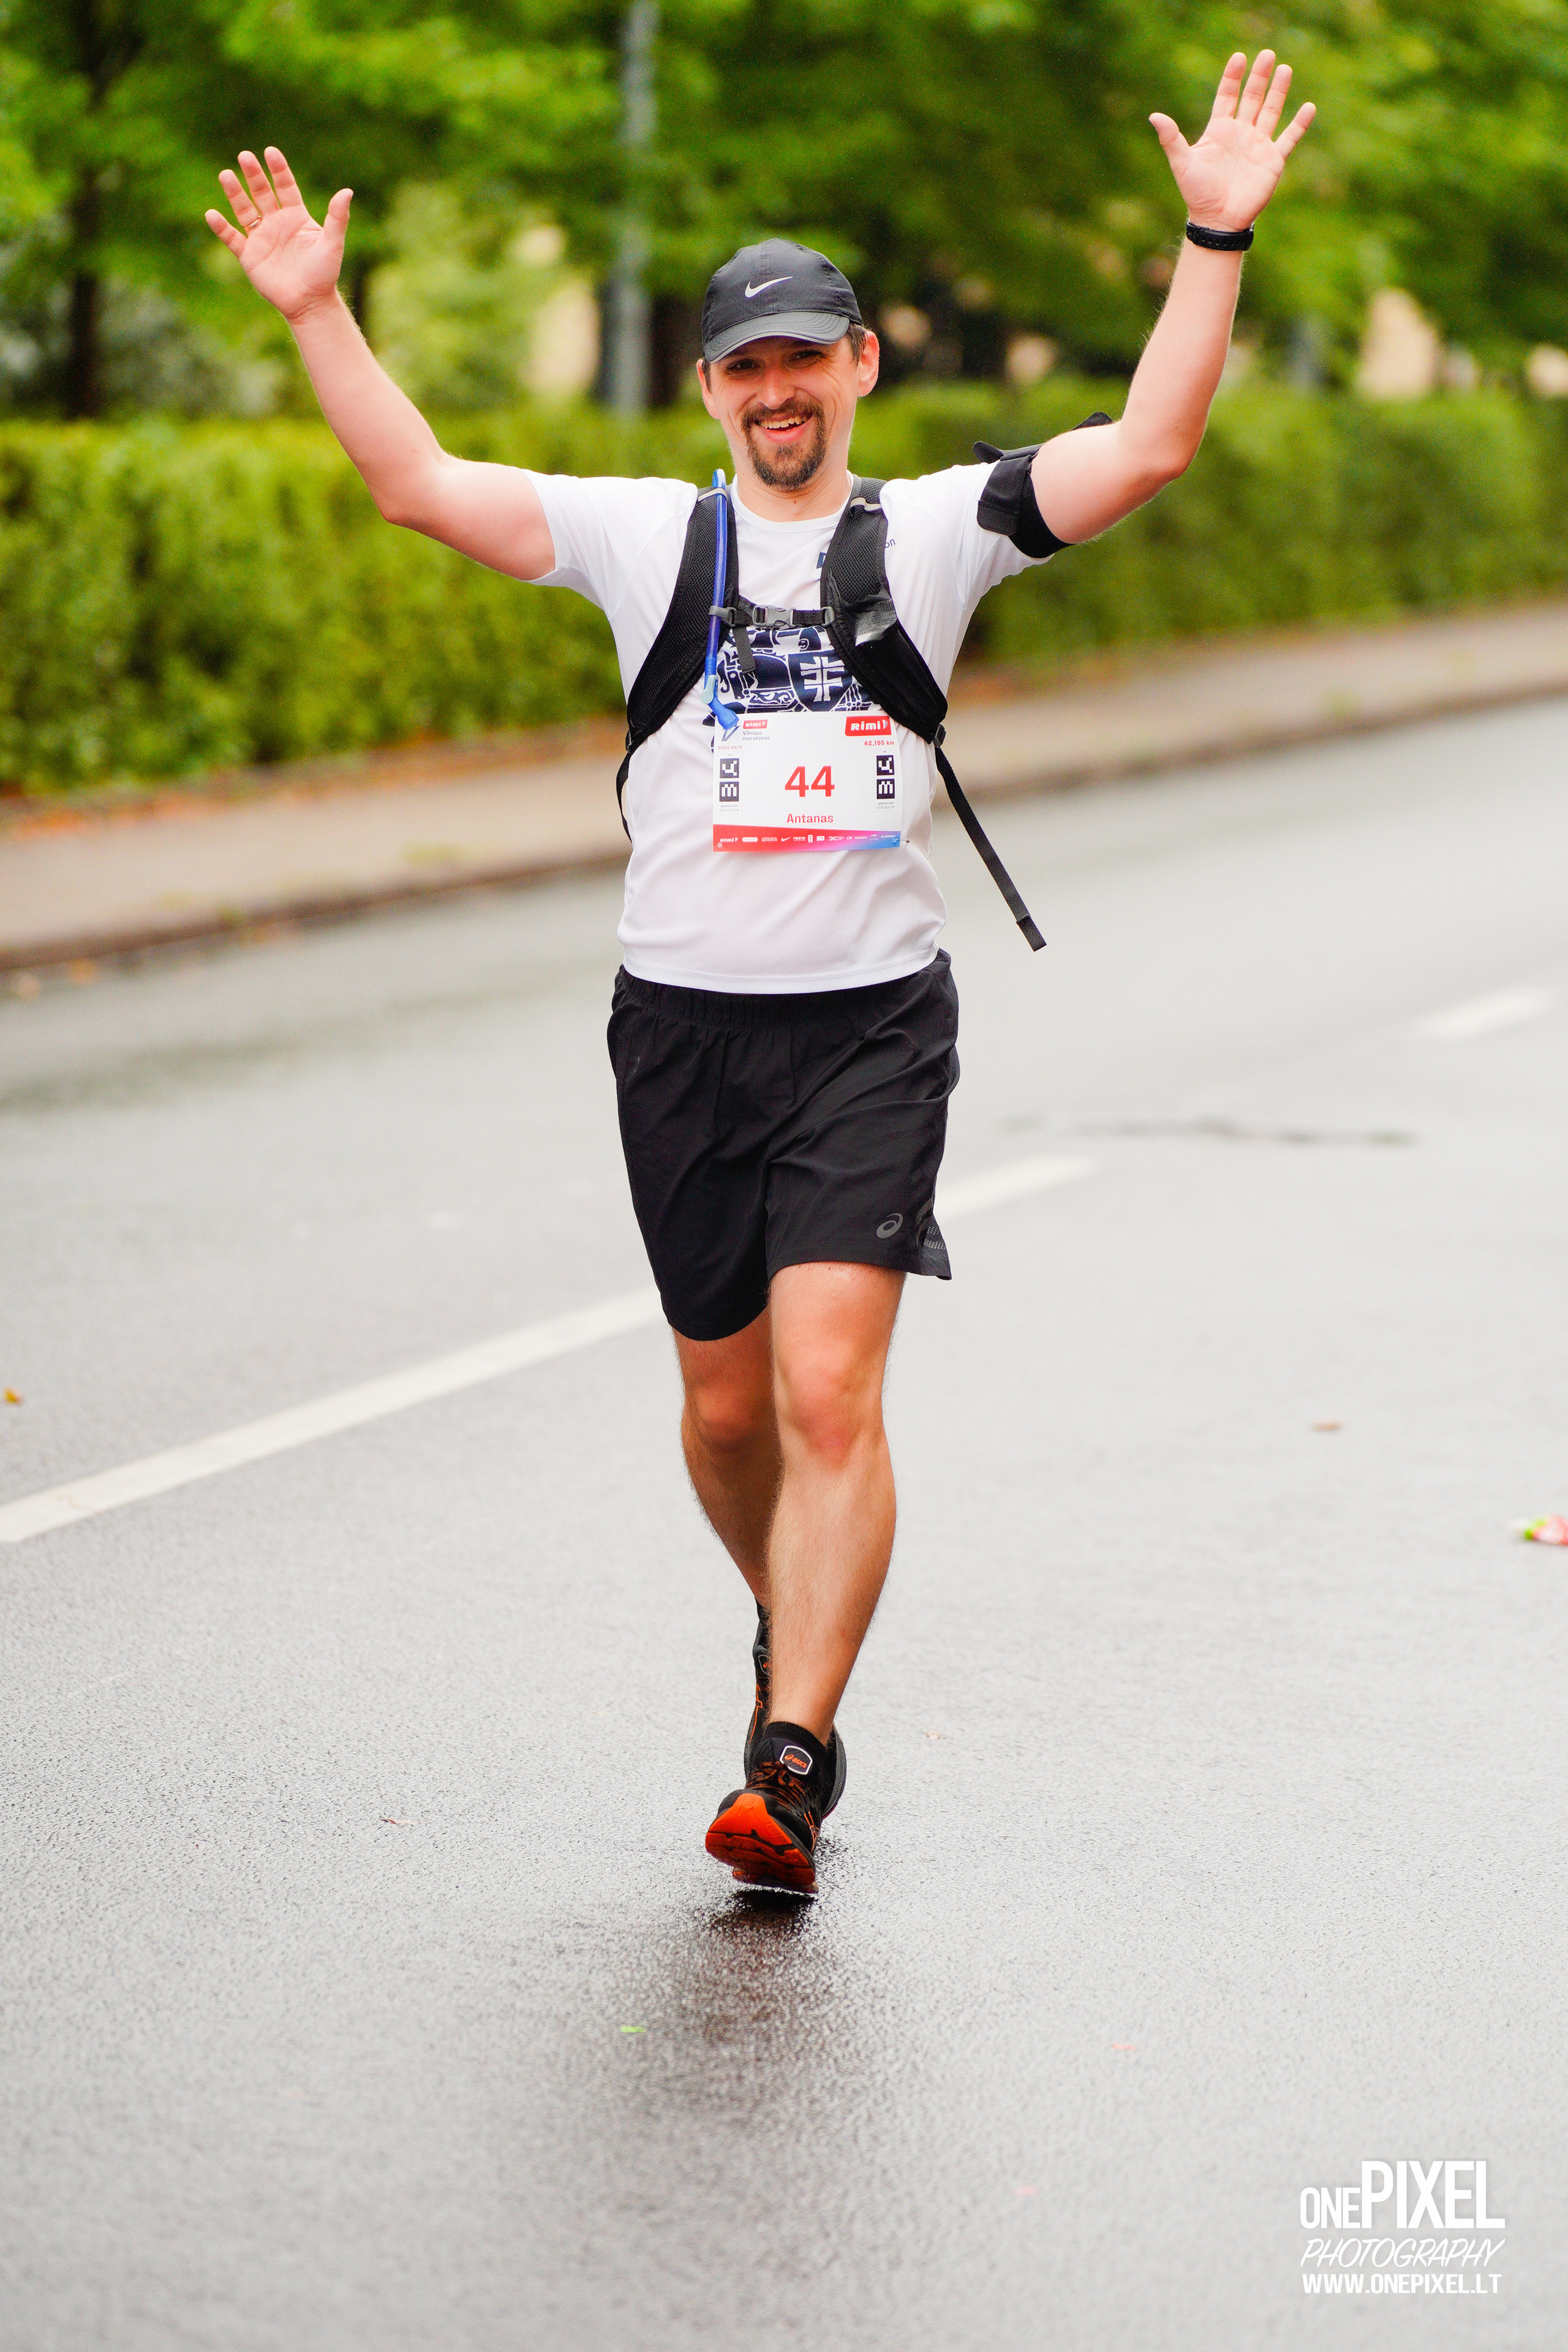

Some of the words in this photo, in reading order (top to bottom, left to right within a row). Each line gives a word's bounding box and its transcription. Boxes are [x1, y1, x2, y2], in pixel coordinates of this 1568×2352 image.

[850, 720, 881, 731] Rimi
[785, 765, 835, 797] 44
[786, 813, 834, 823] Antanas
[792, 1757, 807, 1768] asics
